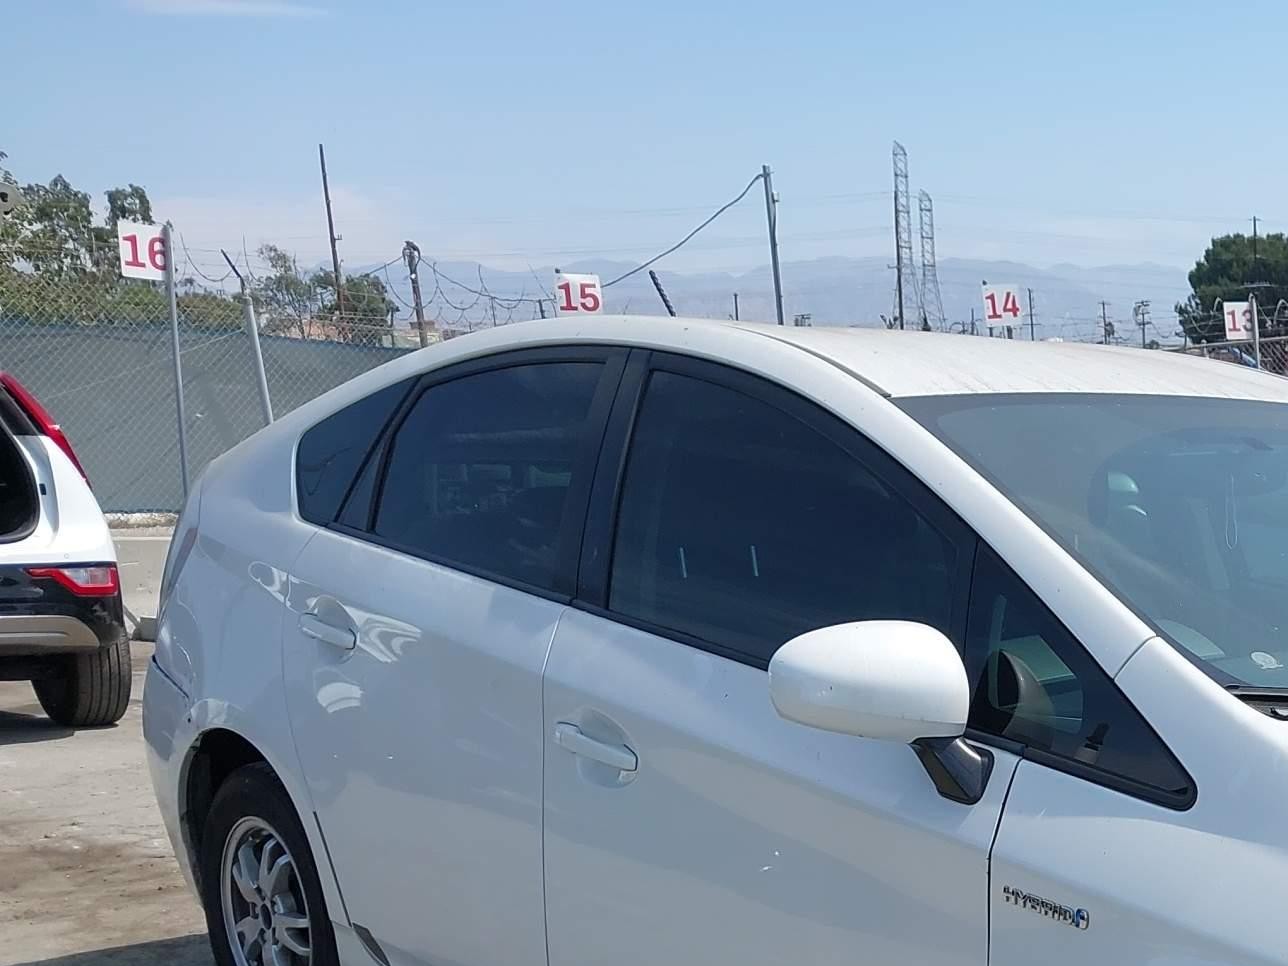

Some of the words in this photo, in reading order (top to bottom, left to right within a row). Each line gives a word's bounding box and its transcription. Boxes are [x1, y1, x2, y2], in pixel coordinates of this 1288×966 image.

[122, 234, 167, 271] 16
[557, 282, 600, 312] 15
[985, 291, 1020, 319] 14
[1229, 309, 1252, 332] 13
